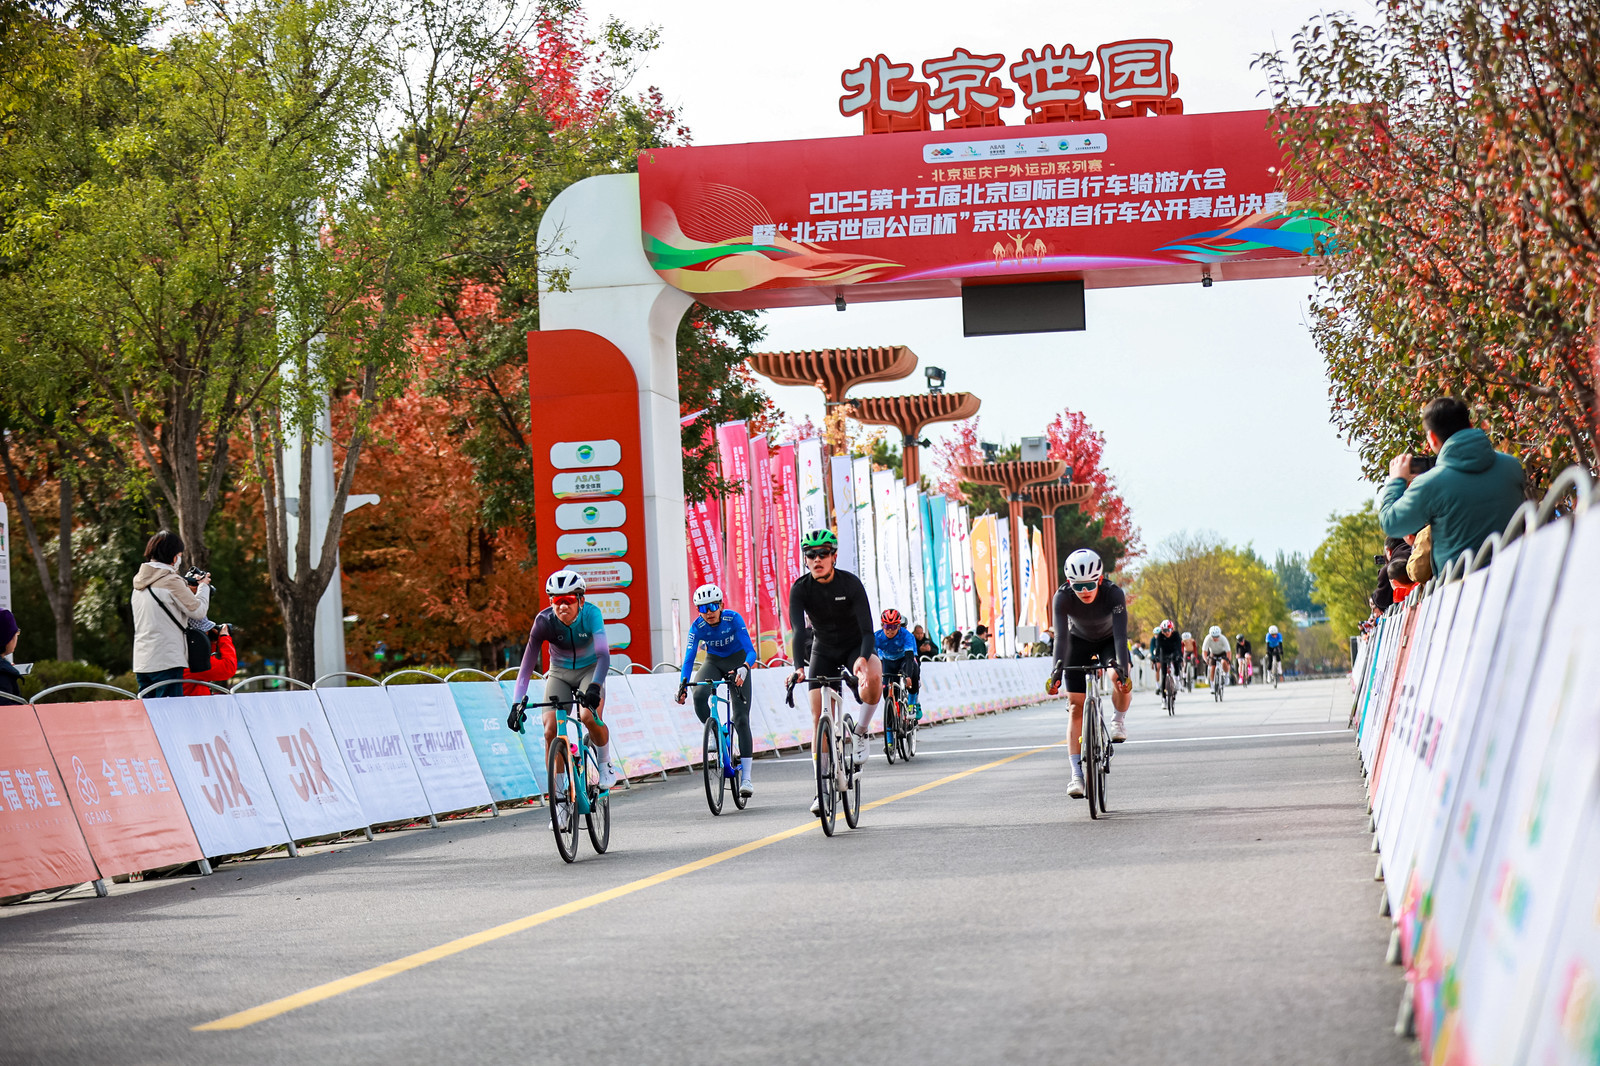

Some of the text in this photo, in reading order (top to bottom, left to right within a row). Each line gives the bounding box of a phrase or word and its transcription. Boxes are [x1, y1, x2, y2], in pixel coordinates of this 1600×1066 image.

[840, 39, 1174, 118] 北京世园
[809, 167, 1227, 215] 2025第十五届北京国际自行车骑游大会
[932, 159, 1103, 182] 北京延庆户外运动系列赛
[0, 767, 62, 812] 福鞍座
